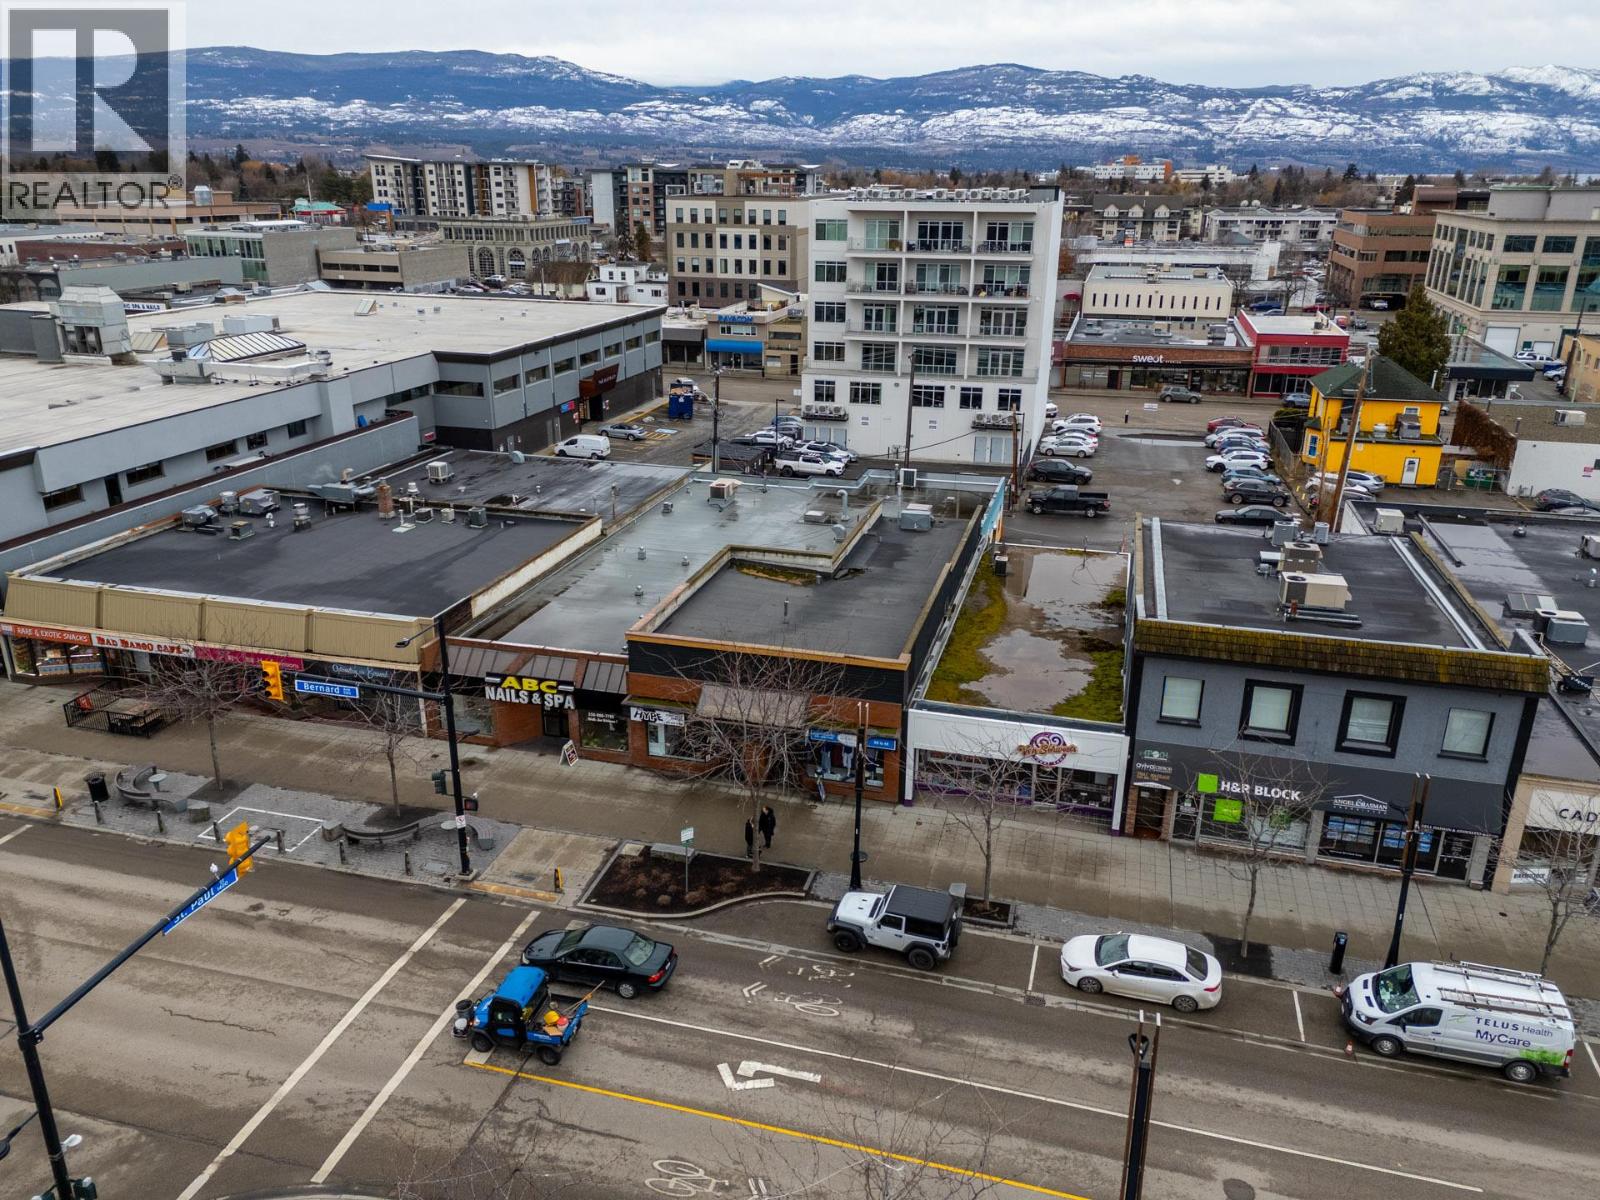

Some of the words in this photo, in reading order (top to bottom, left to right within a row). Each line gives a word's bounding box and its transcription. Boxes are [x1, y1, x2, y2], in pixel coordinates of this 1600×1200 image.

[34, 629, 40, 637] &
[40, 629, 62, 640] EXOTIC
[63, 633, 88, 643] SNACKS
[120, 639, 154, 652] MANGO
[303, 682, 340, 694] Bernard
[501, 676, 558, 693] ABC
[484, 686, 529, 704] NAILS
[531, 692, 542, 705] &
[543, 693, 576, 710] SPA
[633, 709, 663, 723] HYPE
[1220, 780, 1250, 793] H&R
[1254, 785, 1301, 801] BLOCK
[1475, 1016, 1519, 1031] TELUS
[1521, 1024, 1554, 1038] Health
[1475, 1028, 1532, 1048] MyCare
